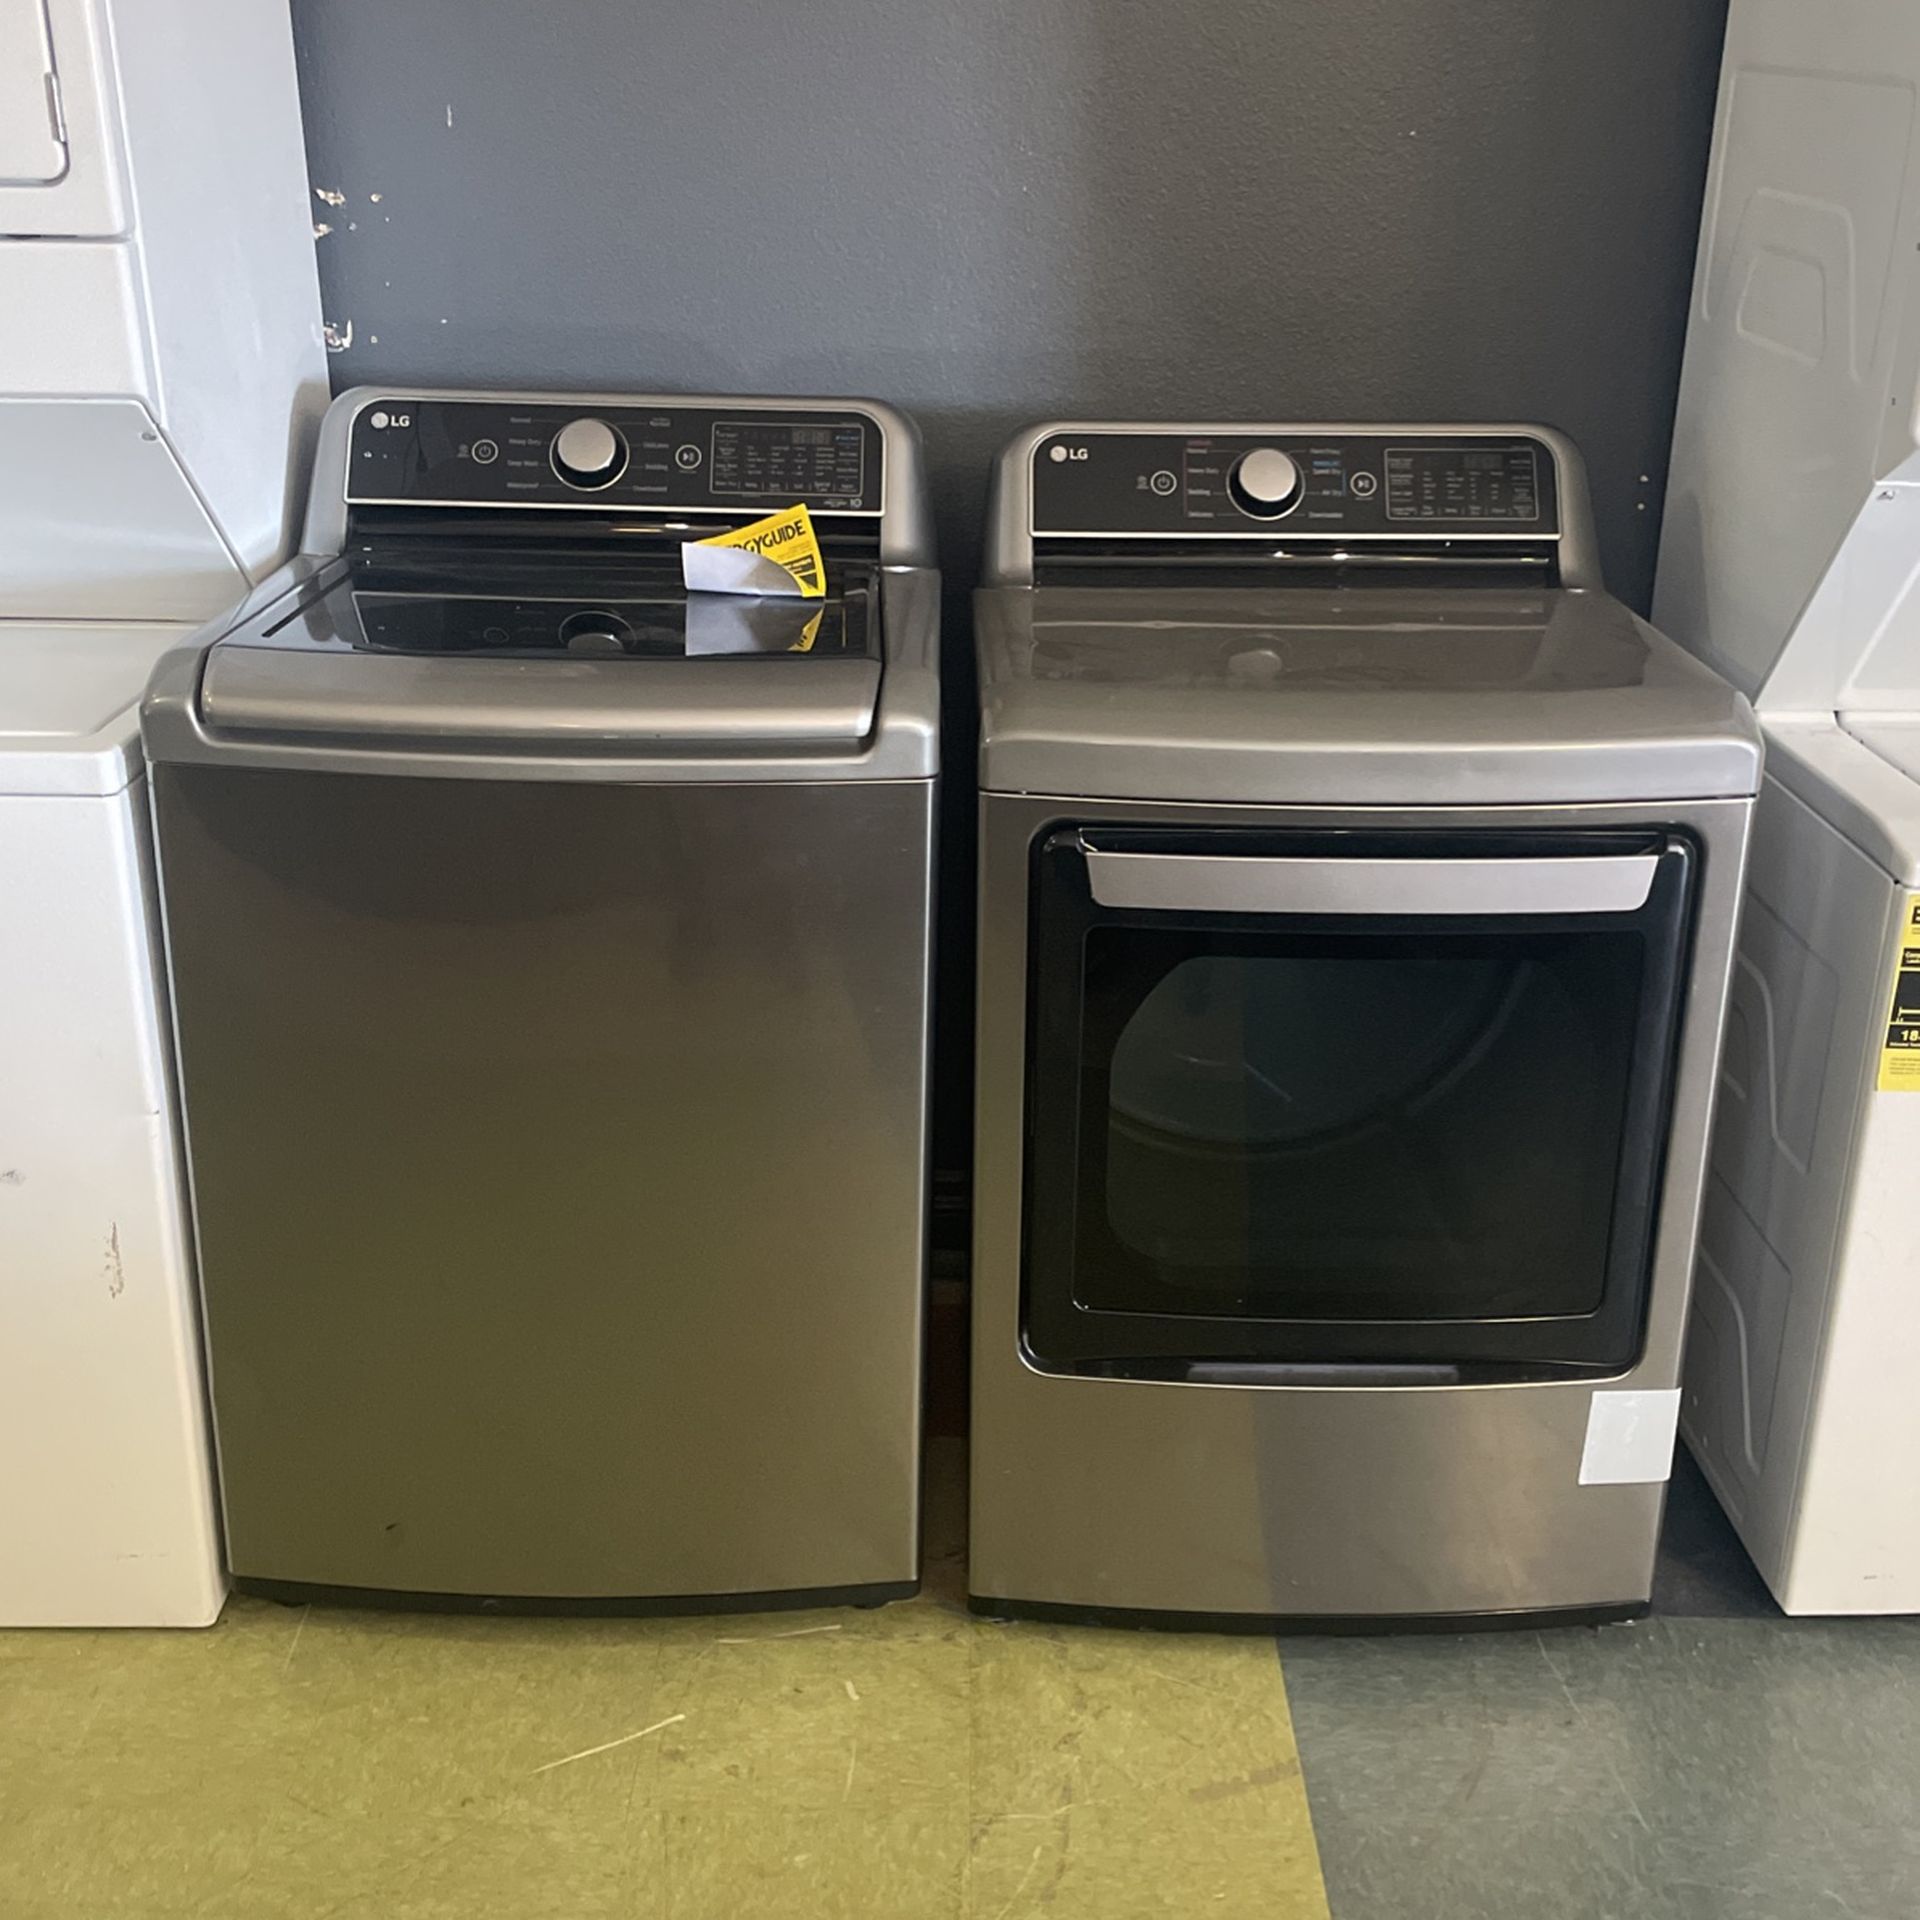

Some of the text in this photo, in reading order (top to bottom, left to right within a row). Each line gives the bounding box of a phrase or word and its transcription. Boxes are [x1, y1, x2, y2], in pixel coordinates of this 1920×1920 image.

[390, 414, 411, 428] LG
[1068, 447, 1089, 460] LG
[728, 519, 807, 554] GYGUIDE
